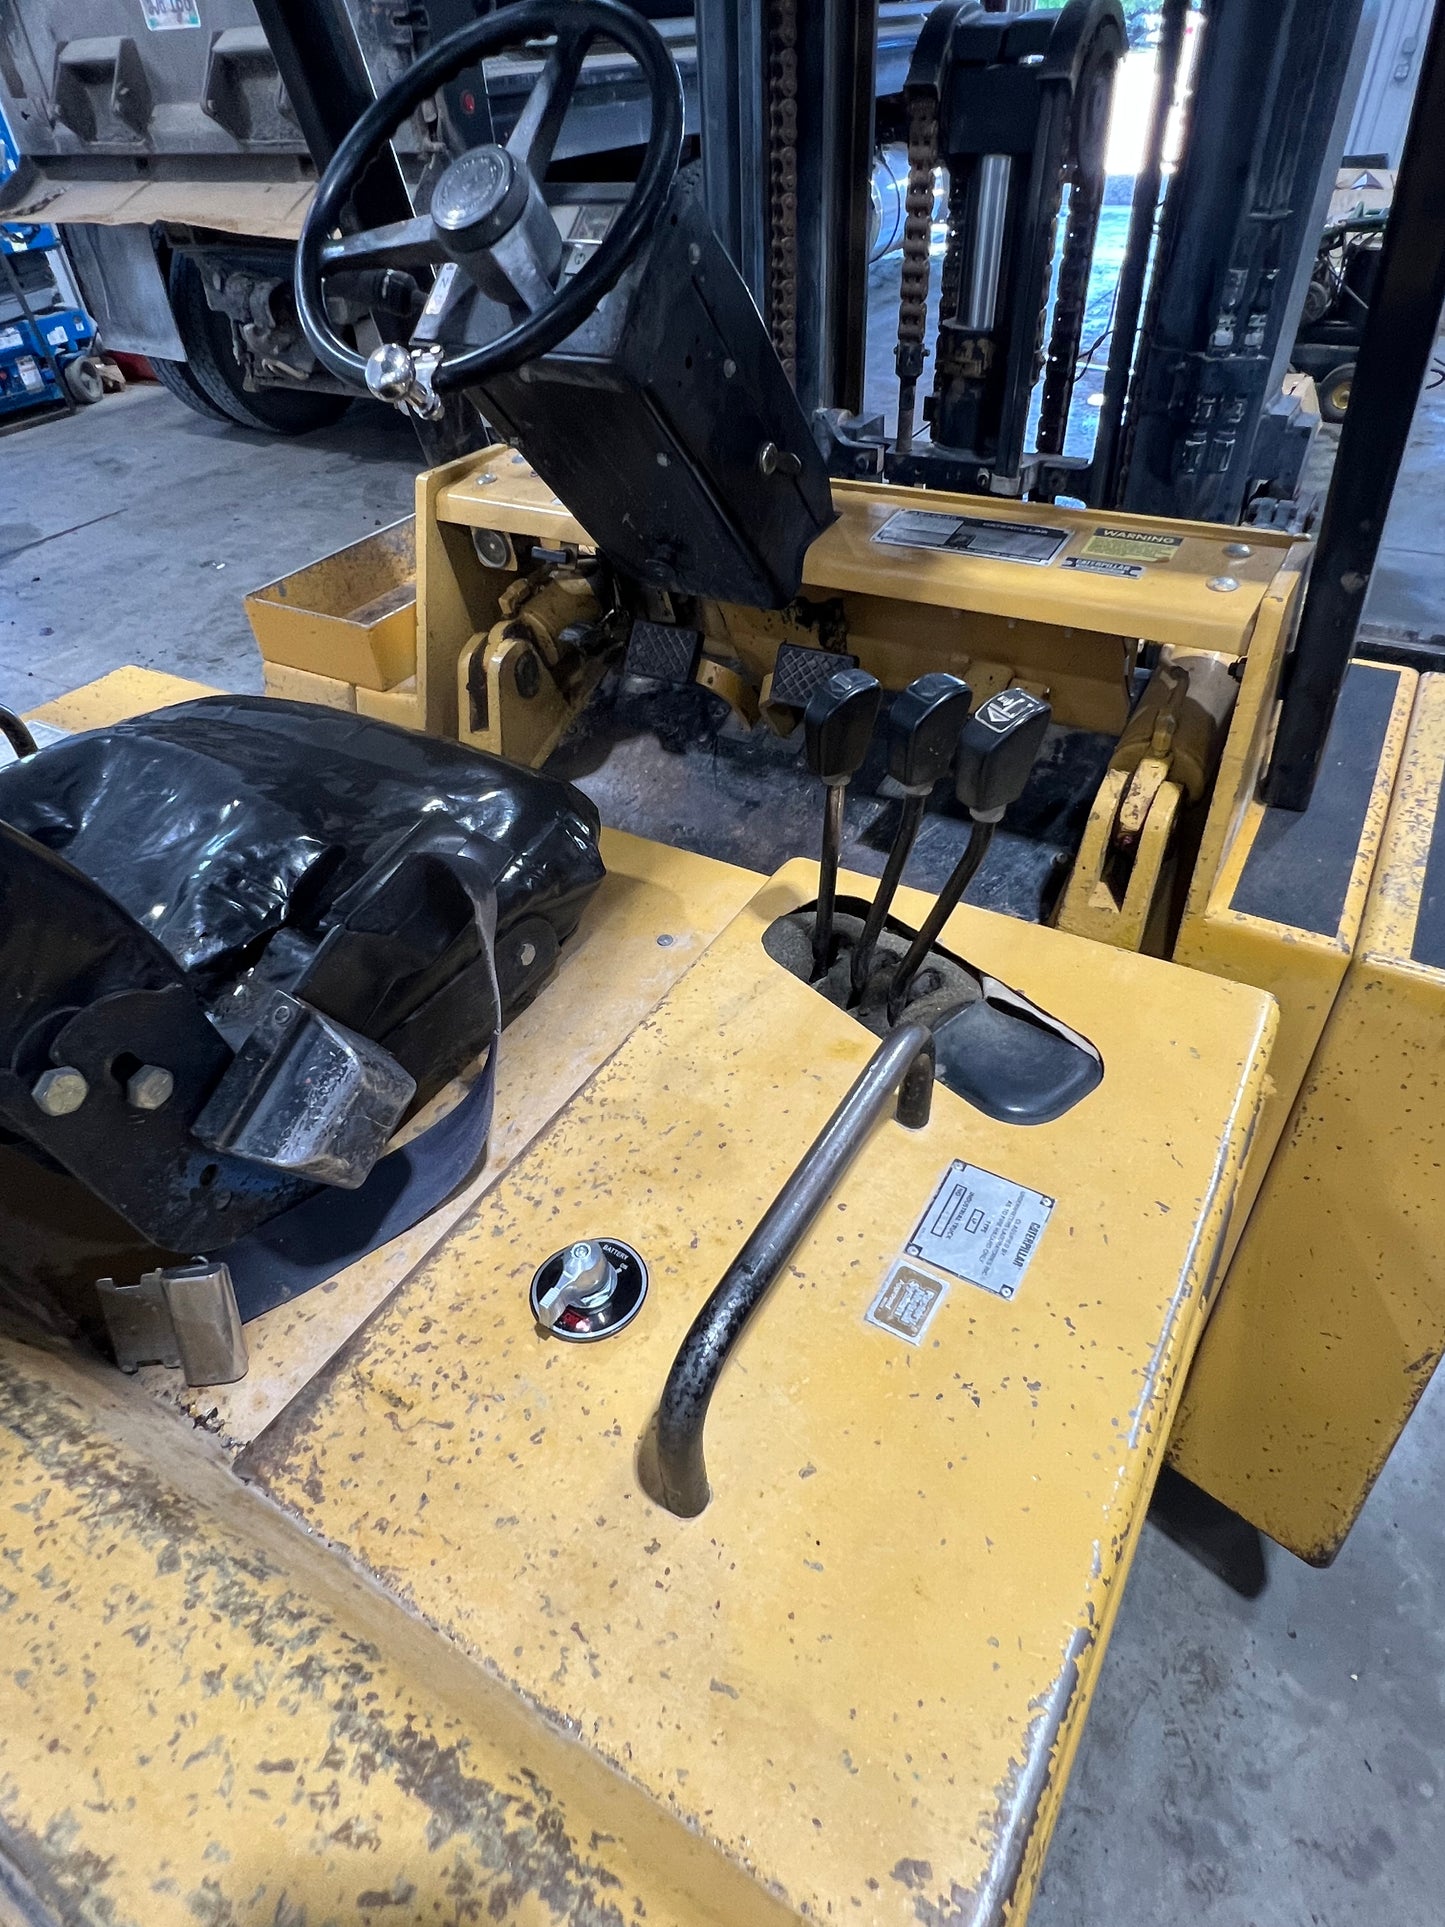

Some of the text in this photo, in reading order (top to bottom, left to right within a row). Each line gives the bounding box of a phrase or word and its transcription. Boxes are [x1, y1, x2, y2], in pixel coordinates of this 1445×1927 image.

[1103, 529, 1175, 544] WARNING
[945, 1191, 975, 1240] INDUSTRIAL TRUCK
[980, 1219, 991, 1233] TYPE
[602, 1244, 629, 1260] BATTERY
[1012, 1221, 1040, 1268] CATERPILLAR
